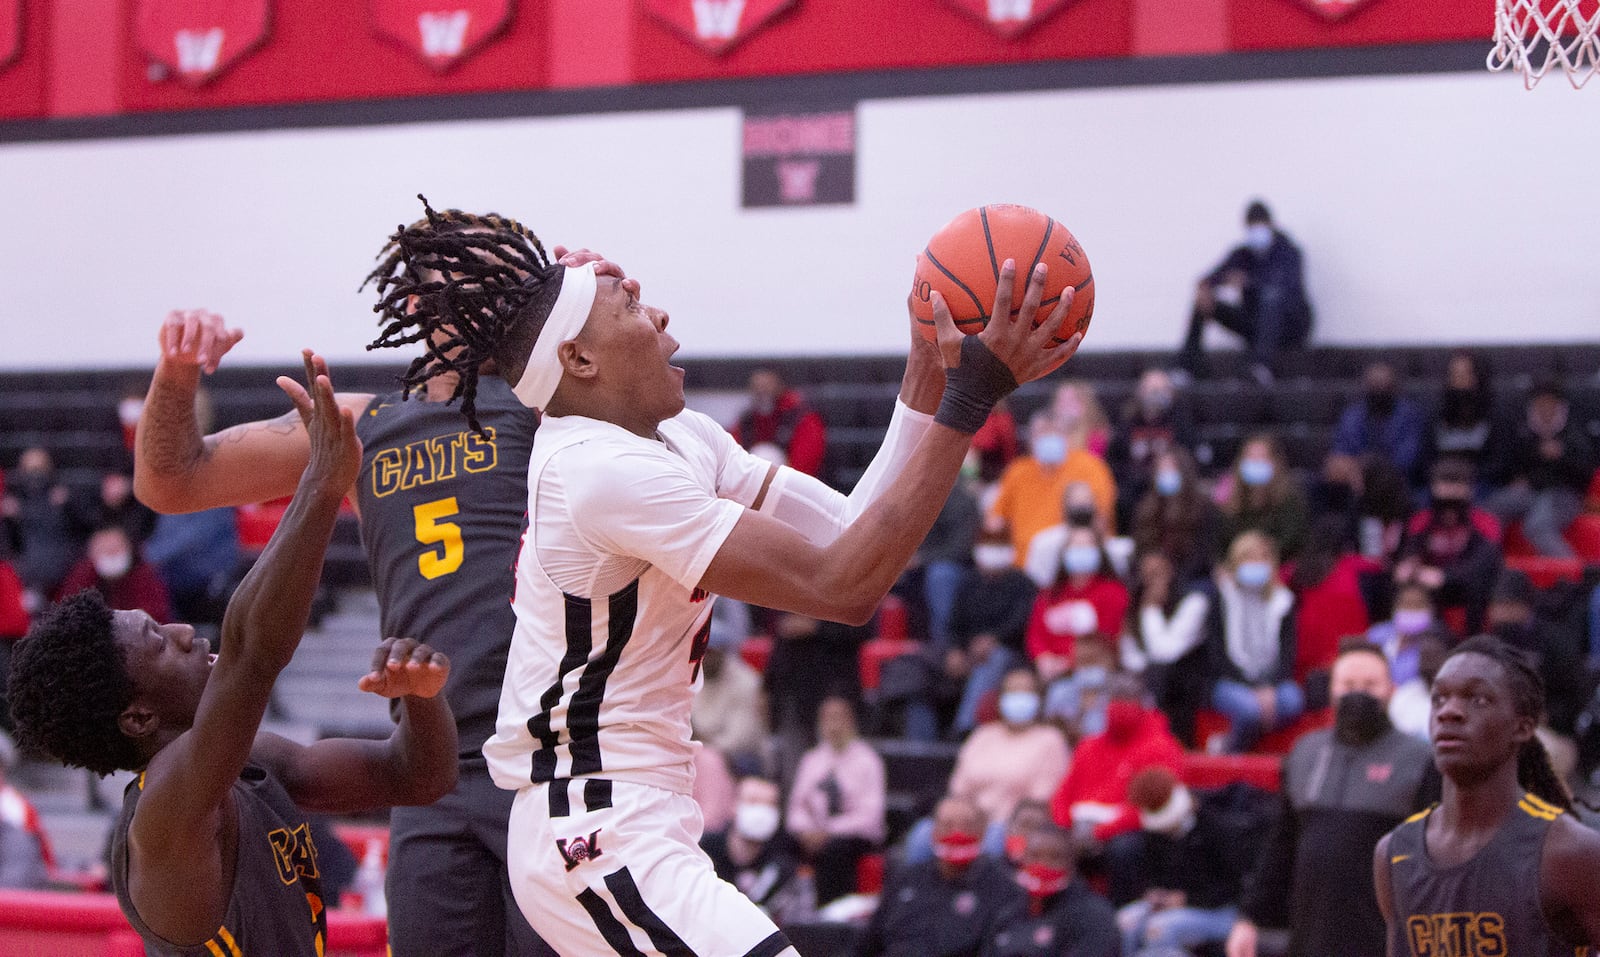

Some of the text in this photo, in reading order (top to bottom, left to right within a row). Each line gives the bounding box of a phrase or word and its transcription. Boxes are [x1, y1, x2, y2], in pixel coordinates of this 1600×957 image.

[175, 26, 225, 73] W
[418, 9, 471, 56] W
[372, 426, 498, 498] CATS
[413, 496, 464, 580] 5
[1406, 911, 1508, 957] CATS
